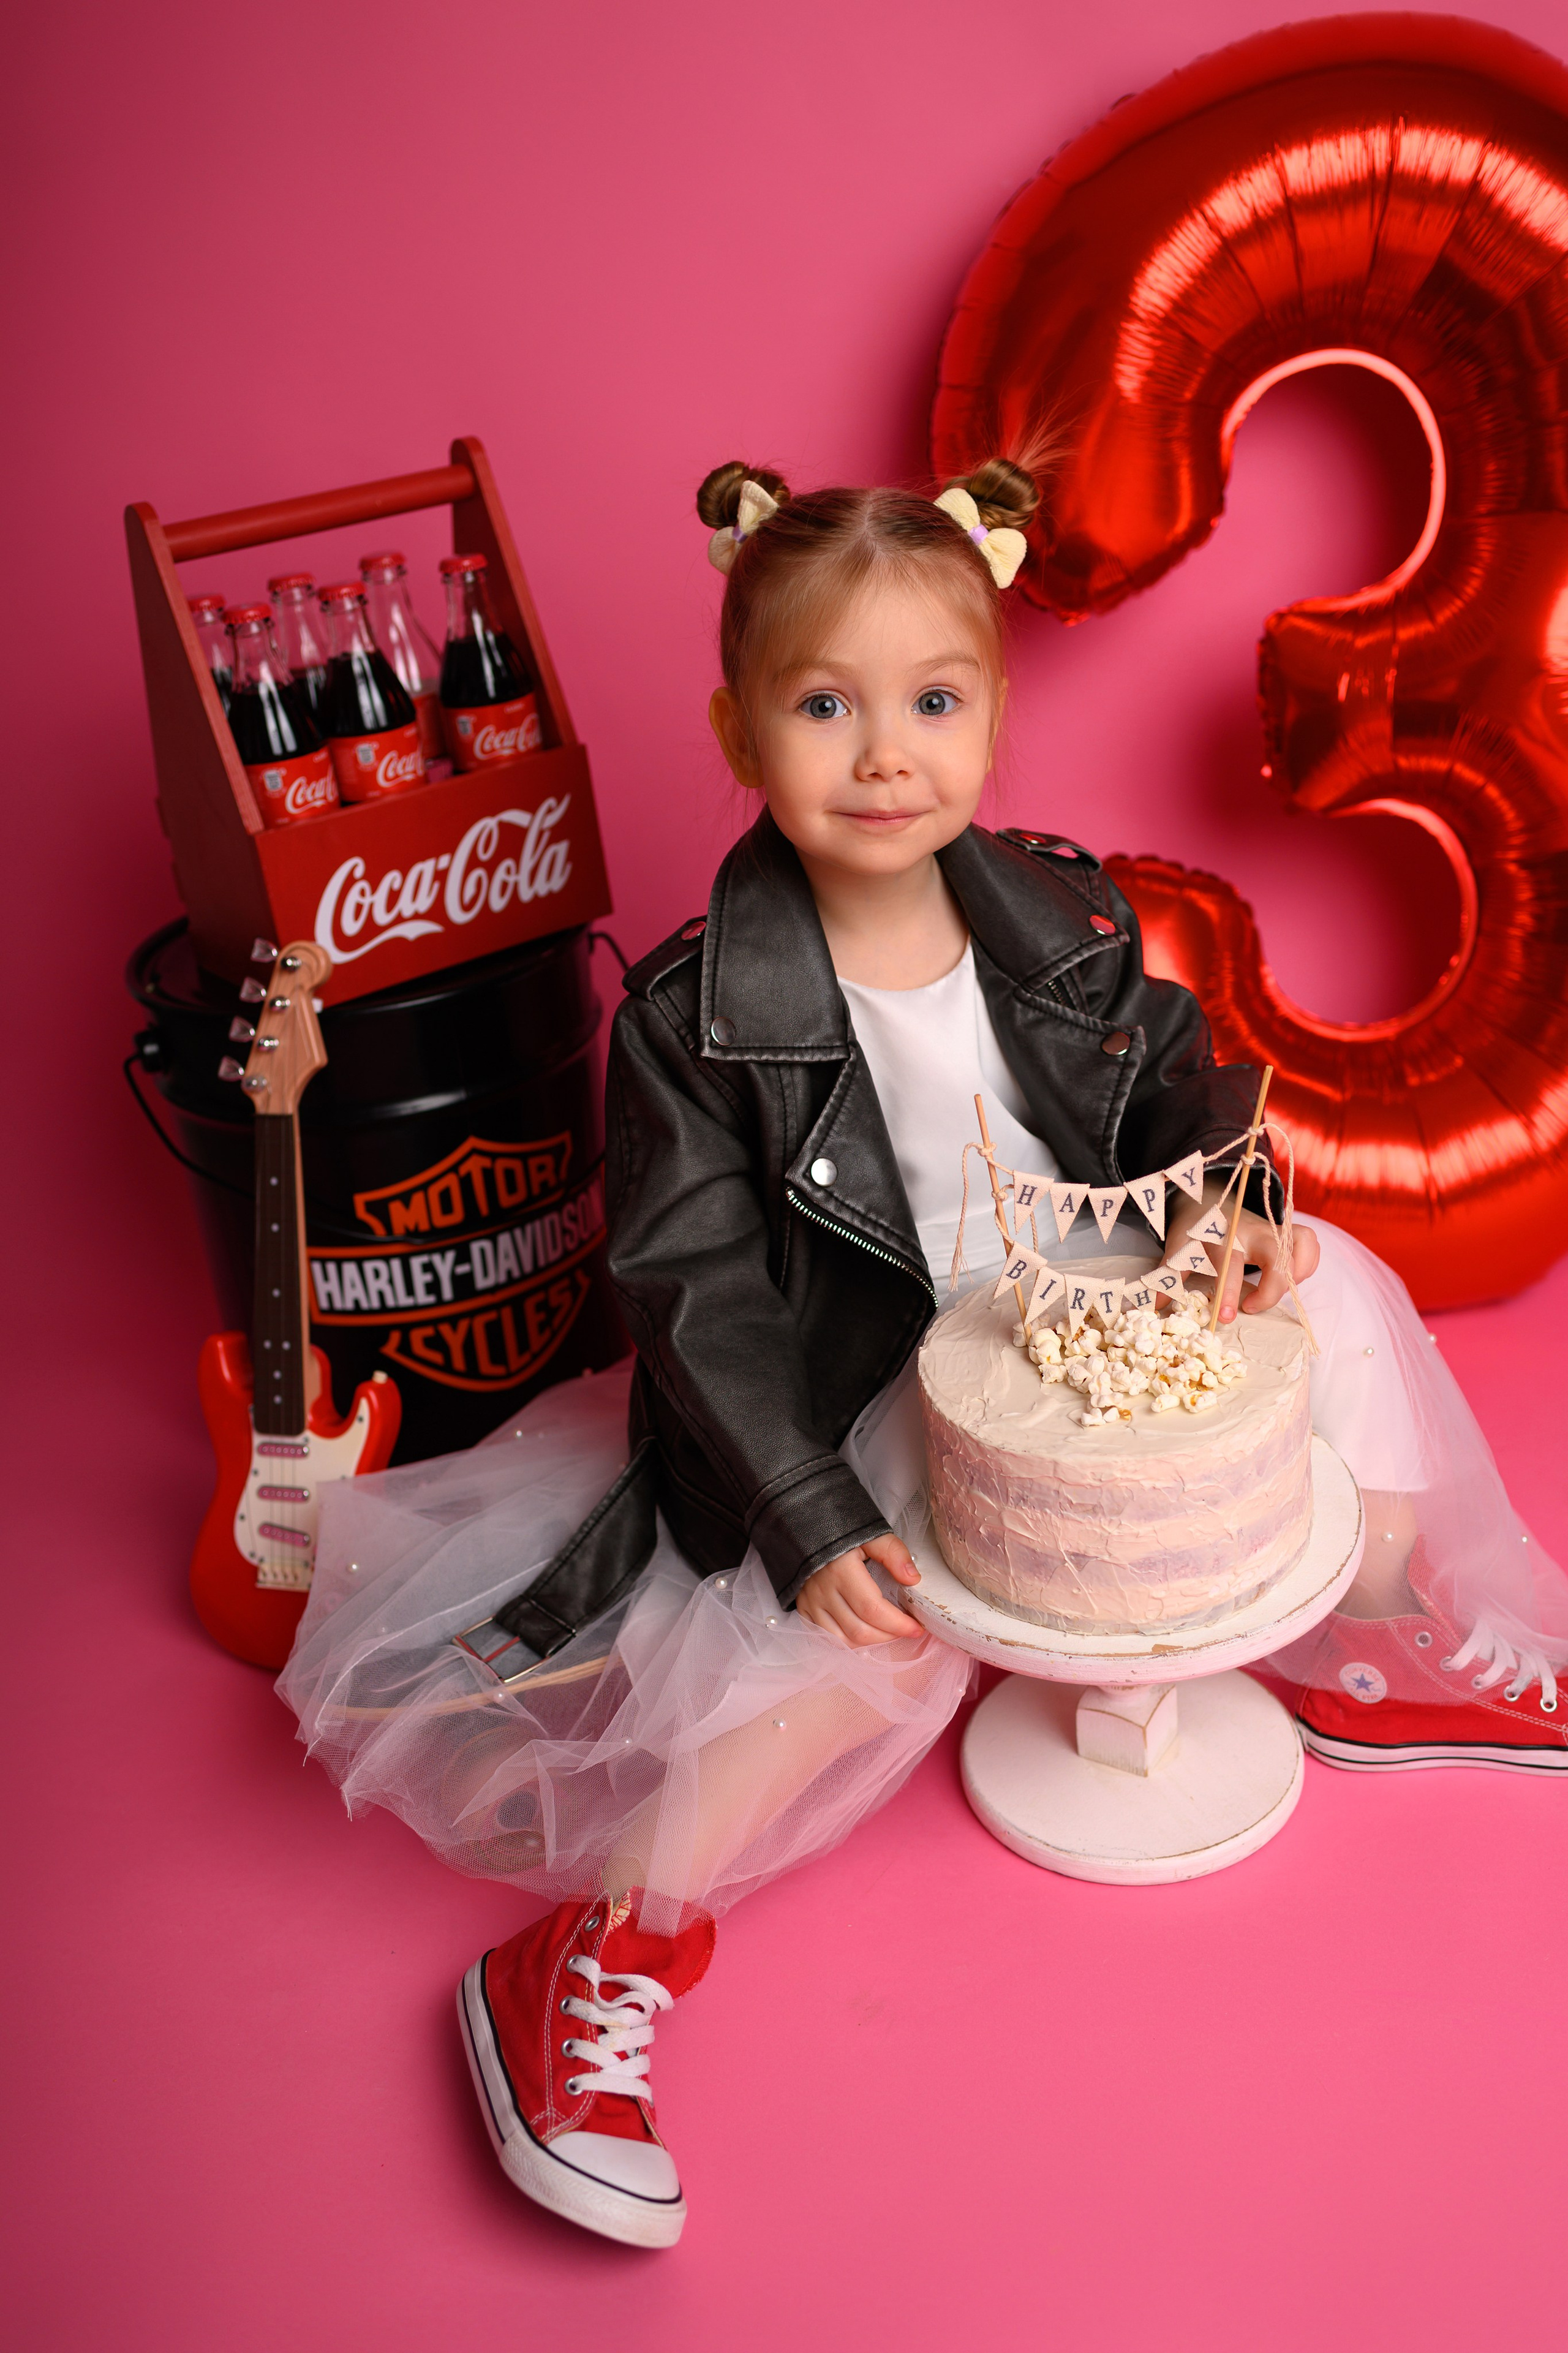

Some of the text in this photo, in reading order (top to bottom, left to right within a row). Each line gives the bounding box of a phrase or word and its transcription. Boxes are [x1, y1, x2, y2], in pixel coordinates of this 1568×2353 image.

[314, 793, 571, 964] Coca-Cola
[389, 1154, 557, 1236] MOTOR
[1016, 1166, 1197, 1217] HAPPY
[311, 1175, 605, 1311] HARLEY-DAVIDSON
[1005, 1222, 1226, 1314] BIRTHDAY
[409, 1277, 573, 1377] CYCLES
